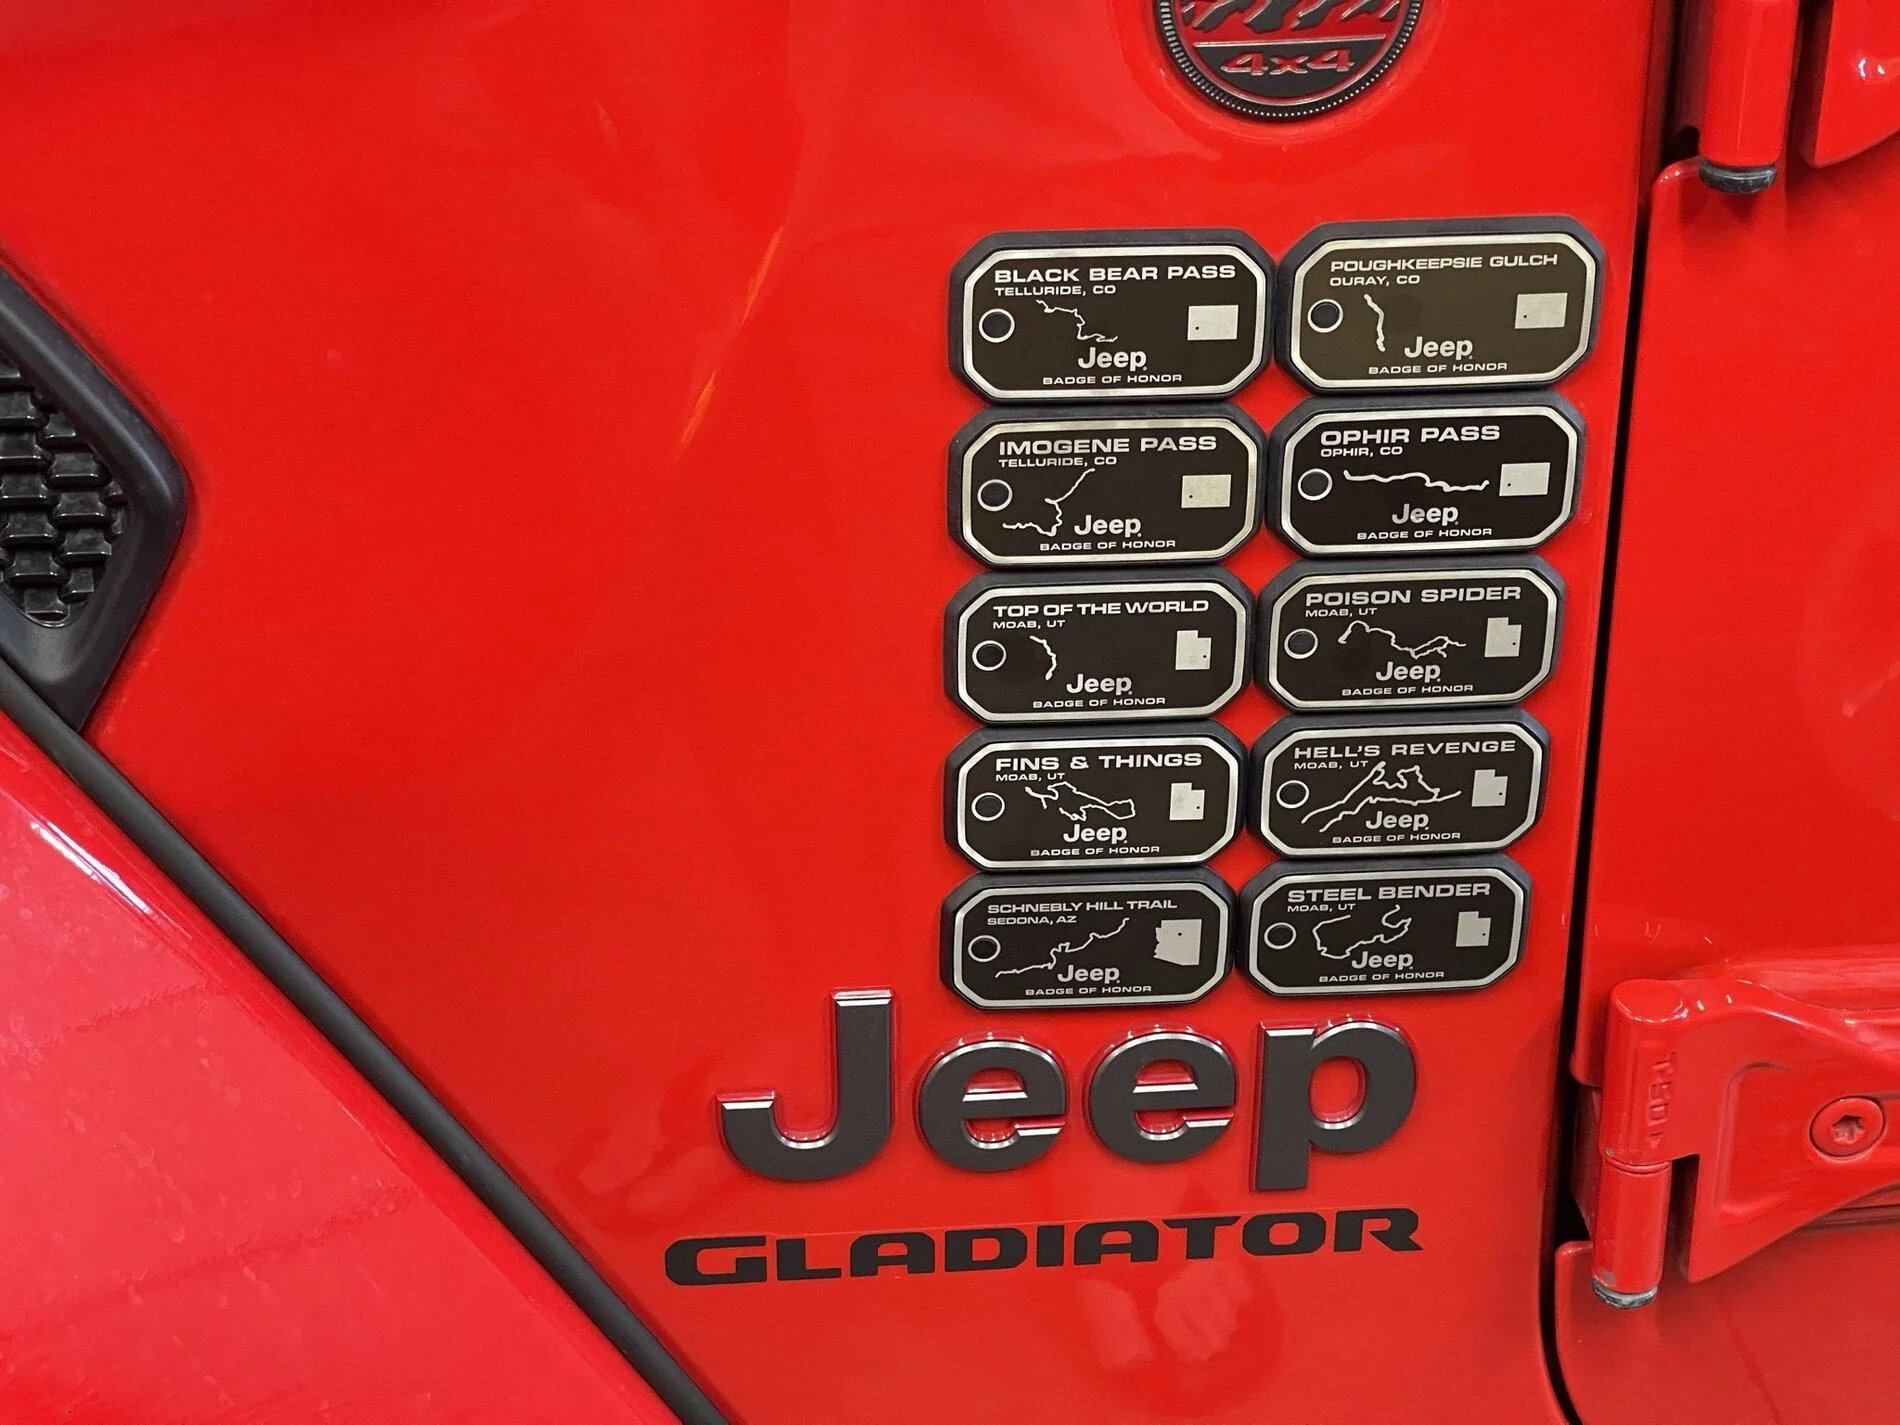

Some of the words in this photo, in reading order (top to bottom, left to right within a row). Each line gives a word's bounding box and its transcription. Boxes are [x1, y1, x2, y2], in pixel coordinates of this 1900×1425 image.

[1220, 50, 1355, 76] 4x4
[1330, 256, 1483, 273] POUGHKEEPSIE
[1489, 253, 1558, 268] GULCH
[994, 268, 1080, 284] BLACK
[1089, 266, 1158, 282] BEAR
[1167, 264, 1236, 280] PASS
[1329, 275, 1390, 287] OURAY,
[1396, 274, 1421, 285] CO
[994, 285, 1087, 297] TELLURIDE,
[1092, 284, 1117, 295] CO
[1403, 335, 1473, 361] Jeep
[1077, 346, 1148, 372] Jeep
[1368, 365, 1422, 375] BADGE
[1426, 364, 1448, 373] OF
[1452, 362, 1508, 372] HONOR
[1042, 376, 1096, 385] BADGE
[1101, 375, 1122, 384] OF
[1127, 374, 1182, 383] HONOR
[1320, 428, 1410, 446] OPHIR
[1420, 425, 1501, 443] PASS
[999, 438, 1130, 456] IMOGENE
[1140, 435, 1217, 452] PASS
[1320, 447, 1374, 458] OPHIR,
[1379, 446, 1404, 456] CO
[998, 457, 1088, 468] TELLURIDE,
[1093, 456, 1118, 466] CO
[1391, 503, 1459, 527] Jeep
[1073, 514, 1142, 538] Jeep
[1356, 530, 1409, 540] BADGE
[1413, 530, 1434, 538] OF
[1438, 528, 1493, 537] HONOR
[1039, 542, 1092, 551] BADGE
[1097, 541, 1117, 550] OF
[1122, 539, 1176, 549] HONOR
[1305, 589, 1411, 607] POISON
[1420, 586, 1522, 603] SPIDER
[992, 604, 1040, 618] TOP
[1043, 603, 1074, 617] OF
[1076, 602, 1122, 615] THE
[1124, 599, 1209, 614] WORLD
[1305, 608, 1354, 619] MOAB,
[1358, 607, 1378, 616] UT
[992, 620, 1041, 630] MOAB,
[1046, 619, 1066, 628] UT
[1375, 661, 1442, 684] Jeep
[1066, 673, 1133, 696] Jeep
[1341, 687, 1393, 697] BADGE
[1397, 686, 1417, 694] OF
[1421, 684, 1474, 694] HONOR
[1032, 699, 1084, 709] BADGE
[1088, 698, 1108, 707] OF
[1113, 697, 1166, 706] HONOR
[1294, 744, 1381, 760] HELL'S
[1391, 739, 1516, 756] REVENGE
[995, 756, 1060, 772] FINS
[1069, 756, 1090, 770] &
[1098, 752, 1202, 769] THINGS
[1293, 761, 1343, 770] MOAB,
[1349, 760, 1369, 768] UT
[995, 773, 1042, 782] MOAB,
[1047, 772, 1066, 780] UT
[1365, 810, 1430, 832] Jeep
[1062, 823, 1128, 845] Jeep
[1332, 835, 1382, 844] BADGE
[1386, 834, 1406, 842] OF
[1409, 832, 1461, 841] HONOR
[1030, 848, 1080, 857] BADGE
[1084, 847, 1104, 855] OF
[1108, 845, 1160, 855] HONOR
[1287, 887, 1373, 904] STEEL
[1378, 882, 1491, 900] BENDER
[987, 902, 1084, 914] SCHNEBLY
[1085, 901, 1124, 911] HILL
[1126, 899, 1178, 910] TRAIL
[1287, 904, 1333, 913] MOAB,
[1337, 902, 1357, 911] UT
[987, 916, 1054, 926] SEDONA,
[1055, 915, 1077, 924] AZ
[1350, 949, 1414, 971] Jeep
[1057, 964, 1121, 985] Jeep
[1318, 974, 1368, 983] BADGE
[1371, 973, 1390, 981] OF
[1394, 971, 1445, 980] HONOR
[1025, 987, 1074, 996] BADGE
[1078, 987, 1097, 995] OF
[1101, 985, 1152, 994] HONOR
[715, 986, 1418, 1192] Jeep
[664, 1207, 1423, 1286] GLADIATOR
